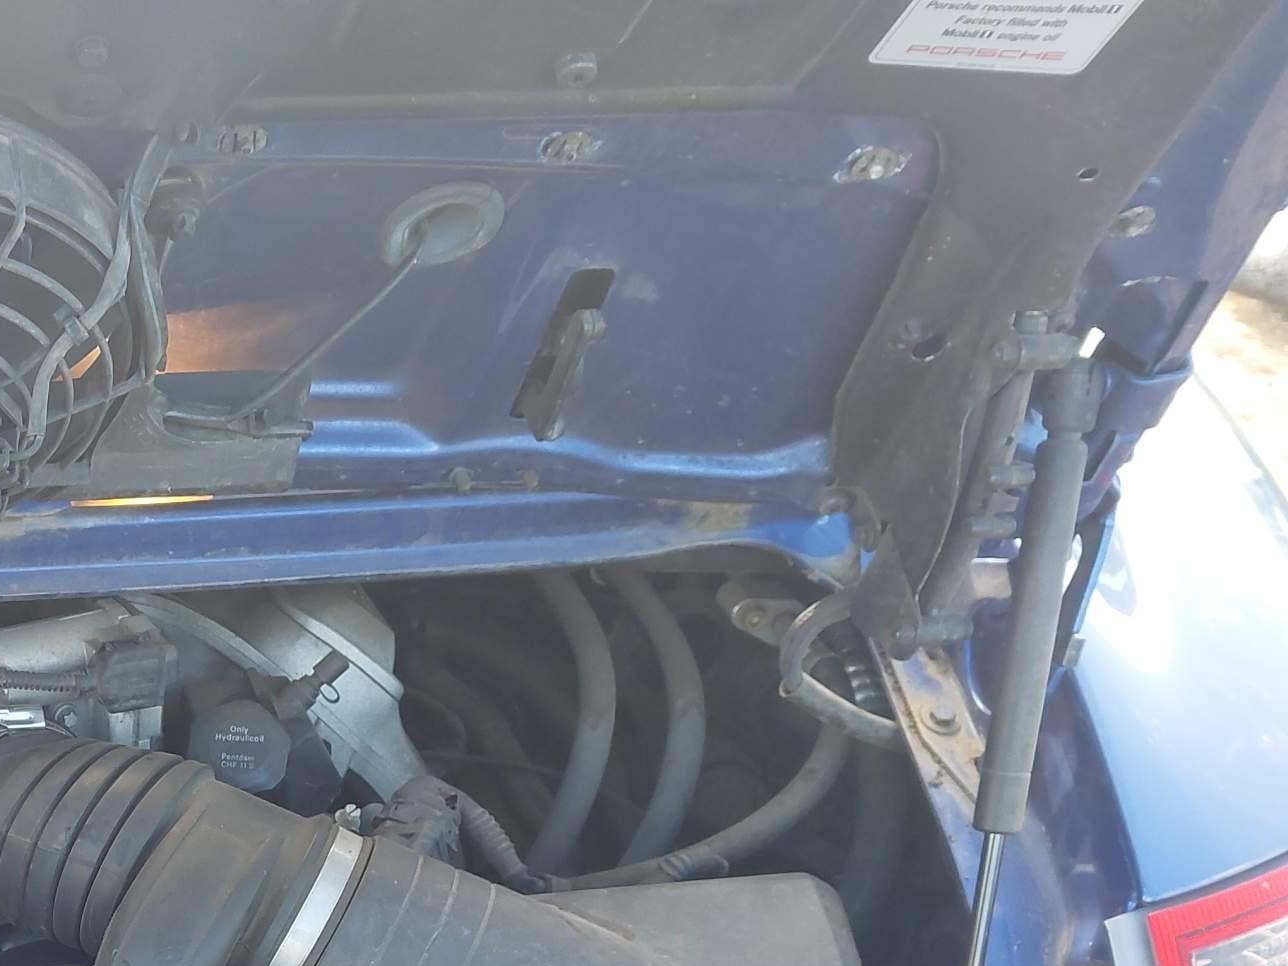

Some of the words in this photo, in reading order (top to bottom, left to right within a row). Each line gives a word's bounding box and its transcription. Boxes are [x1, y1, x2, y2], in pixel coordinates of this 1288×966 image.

[927, 0, 983, 13] Porsche
[955, 15, 1001, 28] Factory
[1007, 17, 1039, 27] filled
[1042, 18, 1068, 28] with
[997, 31, 1040, 42] engine
[906, 44, 1065, 61] PORSCHE
[230, 725, 249, 735] Only
